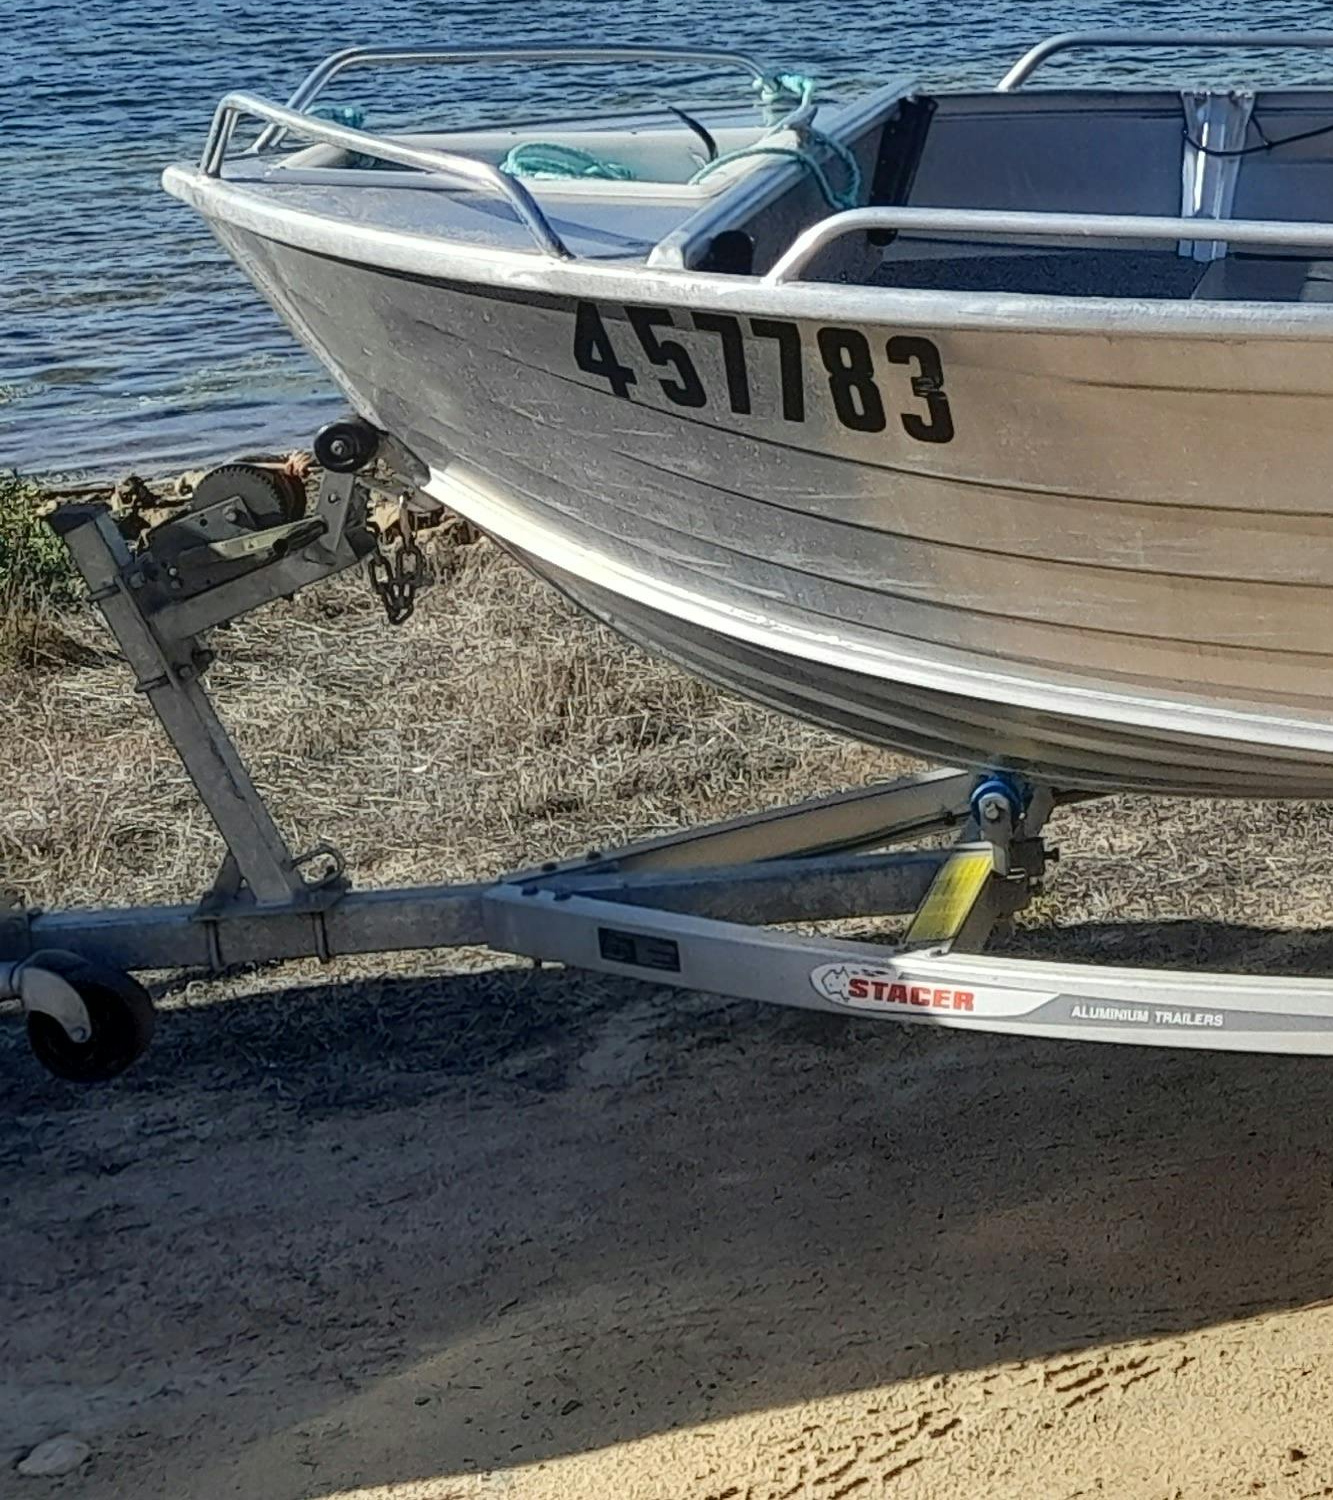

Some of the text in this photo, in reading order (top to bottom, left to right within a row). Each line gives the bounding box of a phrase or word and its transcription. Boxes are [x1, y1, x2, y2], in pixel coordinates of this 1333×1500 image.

[573, 300, 955, 444] 457783
[847, 978, 974, 1012] STACER
[1071, 1004, 1224, 1027] ALUMINIUM TRAILERS
